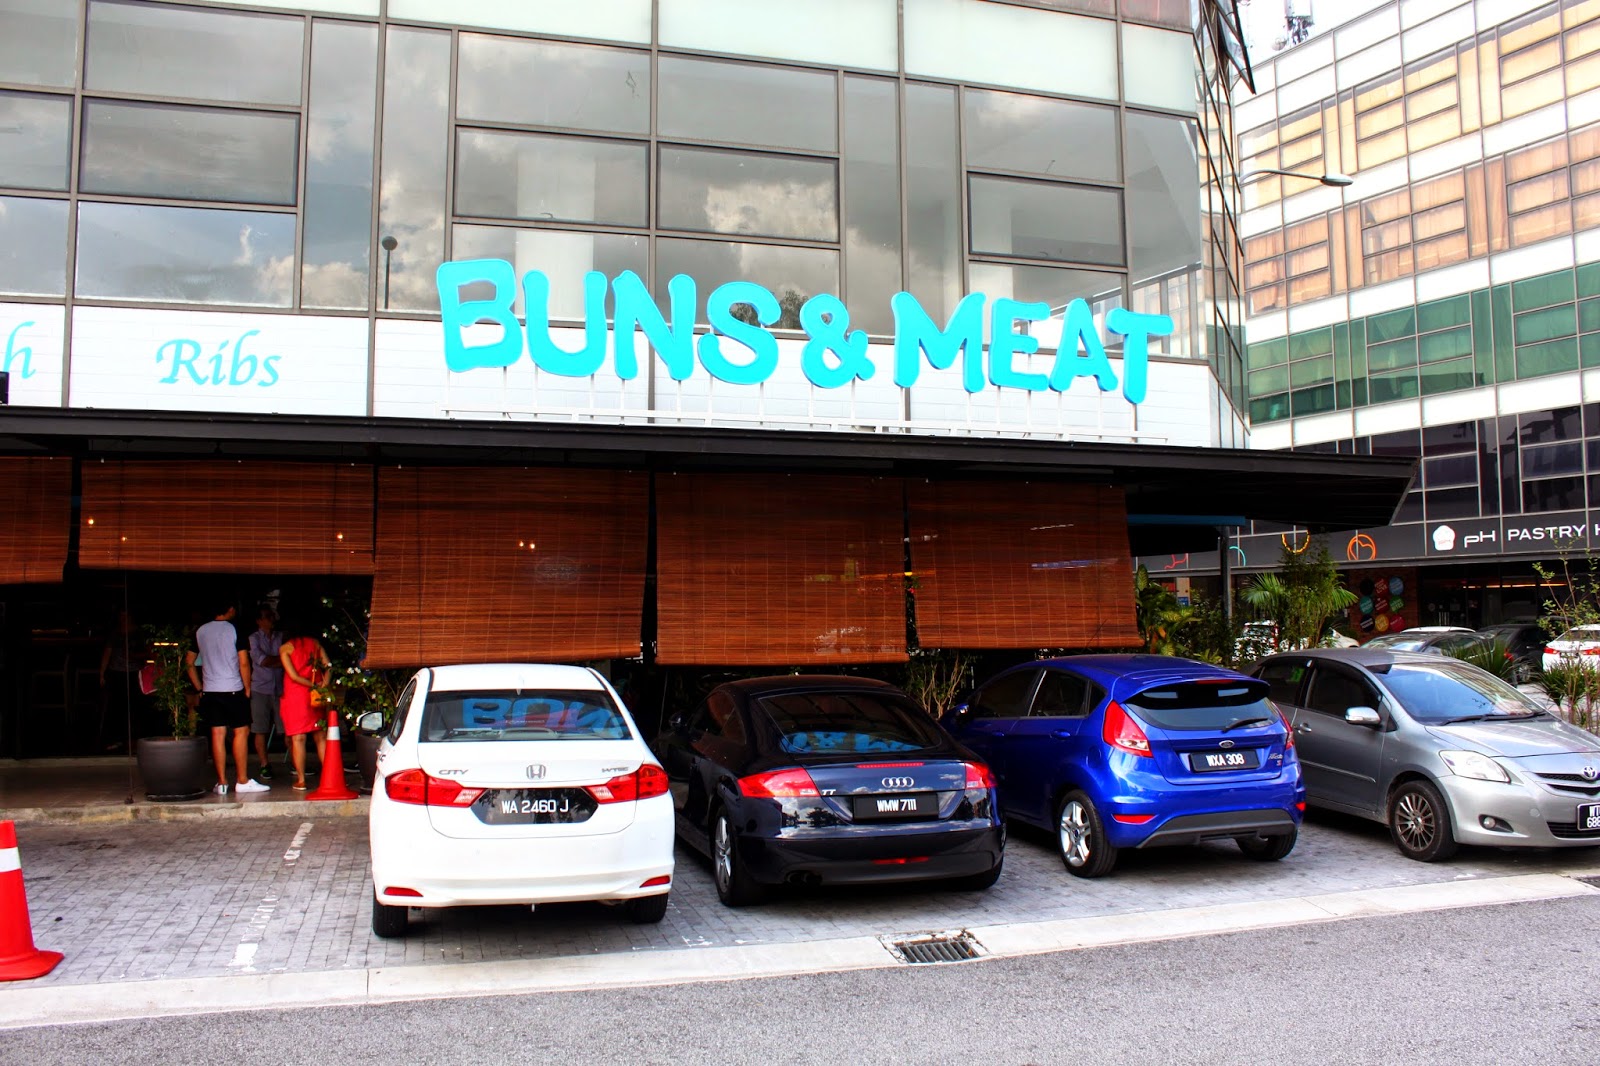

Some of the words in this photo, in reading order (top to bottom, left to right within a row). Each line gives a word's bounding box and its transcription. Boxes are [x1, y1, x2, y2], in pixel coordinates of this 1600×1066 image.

[436, 257, 780, 386] BUNS
[799, 293, 876, 389] &
[891, 290, 1174, 405] MEAT
[155, 329, 282, 387] Ribs
[1464, 530, 1496, 548] pH
[1507, 524, 1586, 541] PASTRY
[1206, 755, 1226, 767] WXA
[1226, 754, 1245, 765] 308
[501, 801, 518, 814] WA
[521, 800, 556, 813] 2460
[559, 799, 569, 813] J
[877, 799, 899, 812] WMW
[900, 798, 917, 811] 7111
